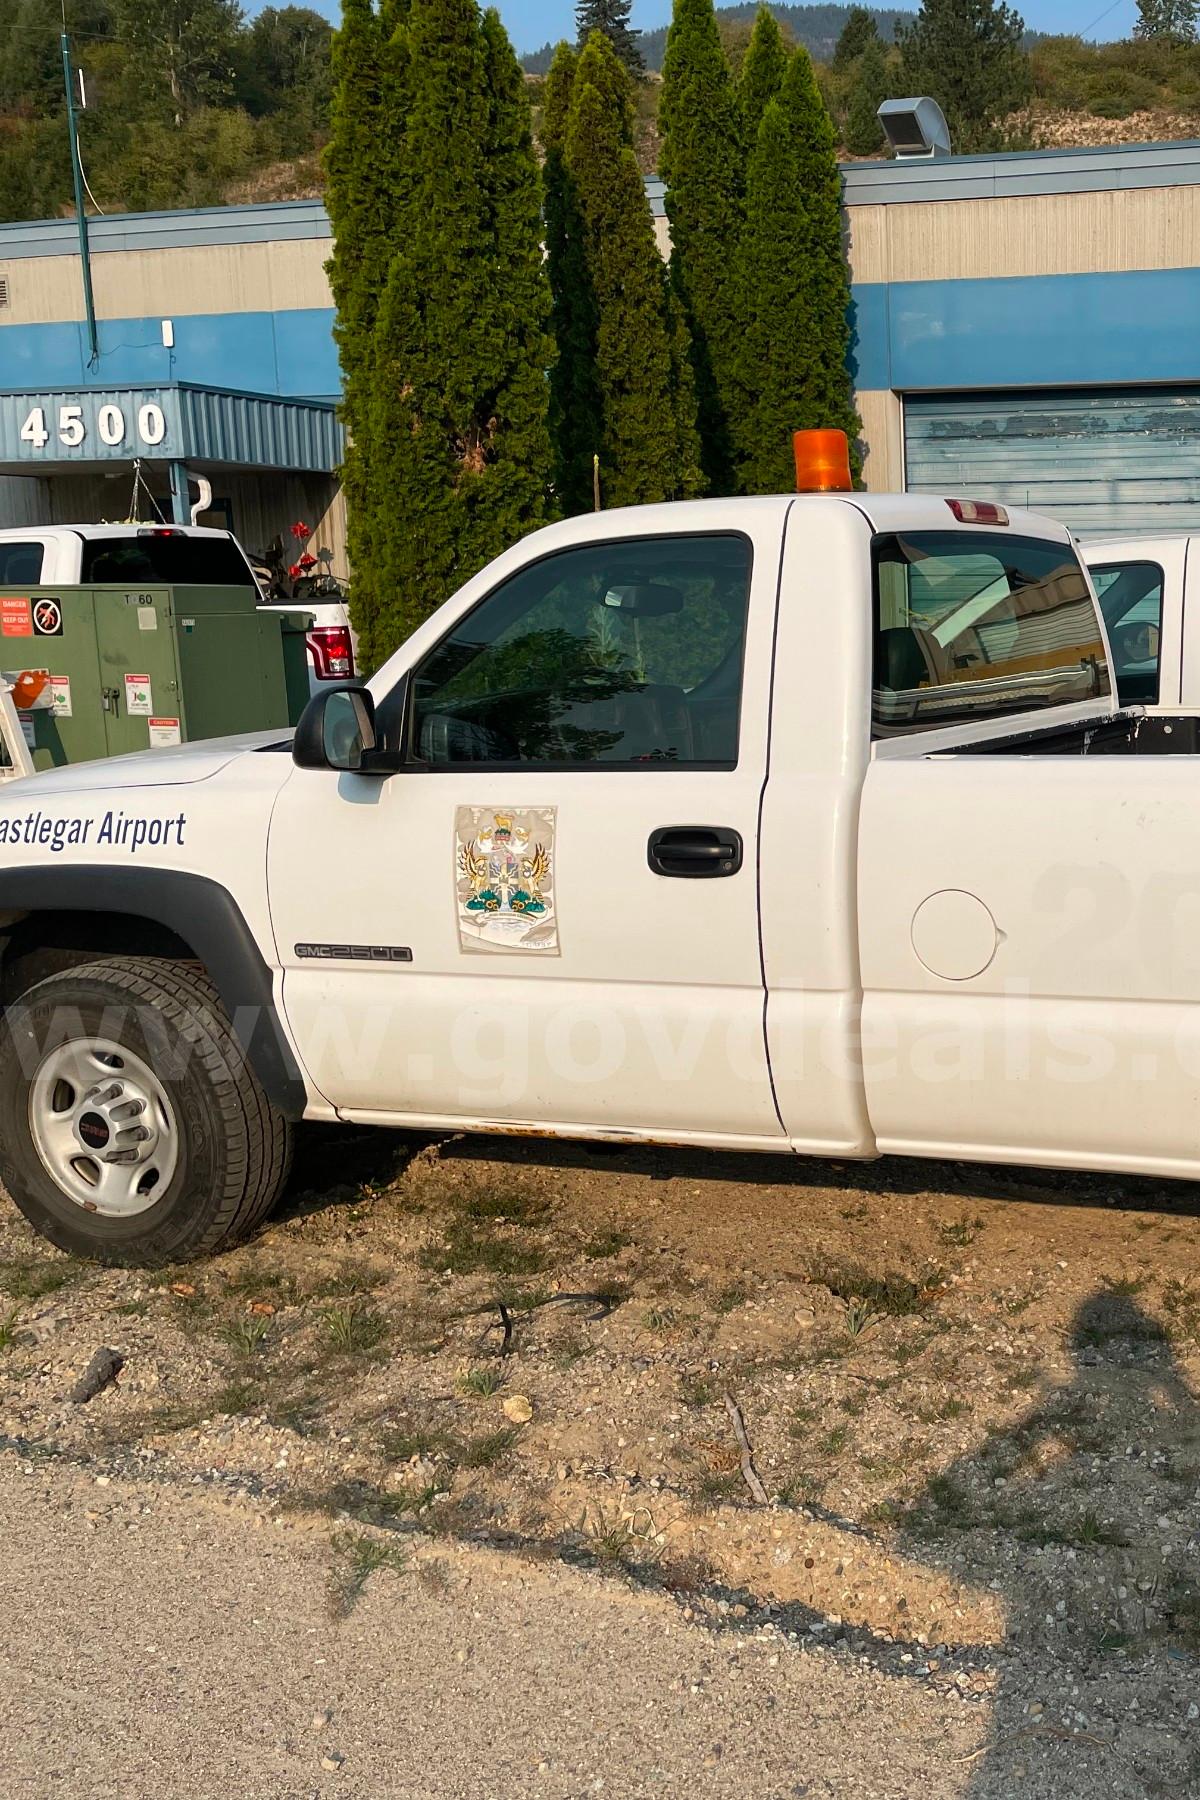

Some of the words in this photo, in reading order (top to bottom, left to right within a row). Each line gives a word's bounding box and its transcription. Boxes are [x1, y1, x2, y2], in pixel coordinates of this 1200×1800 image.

[20, 404, 165, 447] 4500
[2, 600, 27, 609] DANGER
[3, 616, 17, 624] KEEP
[17, 616, 29, 625] OUT
[0, 811, 94, 852] astlegar
[97, 811, 187, 853] Airport
[295, 945, 331, 958] GMC
[331, 946, 412, 961] 2500
